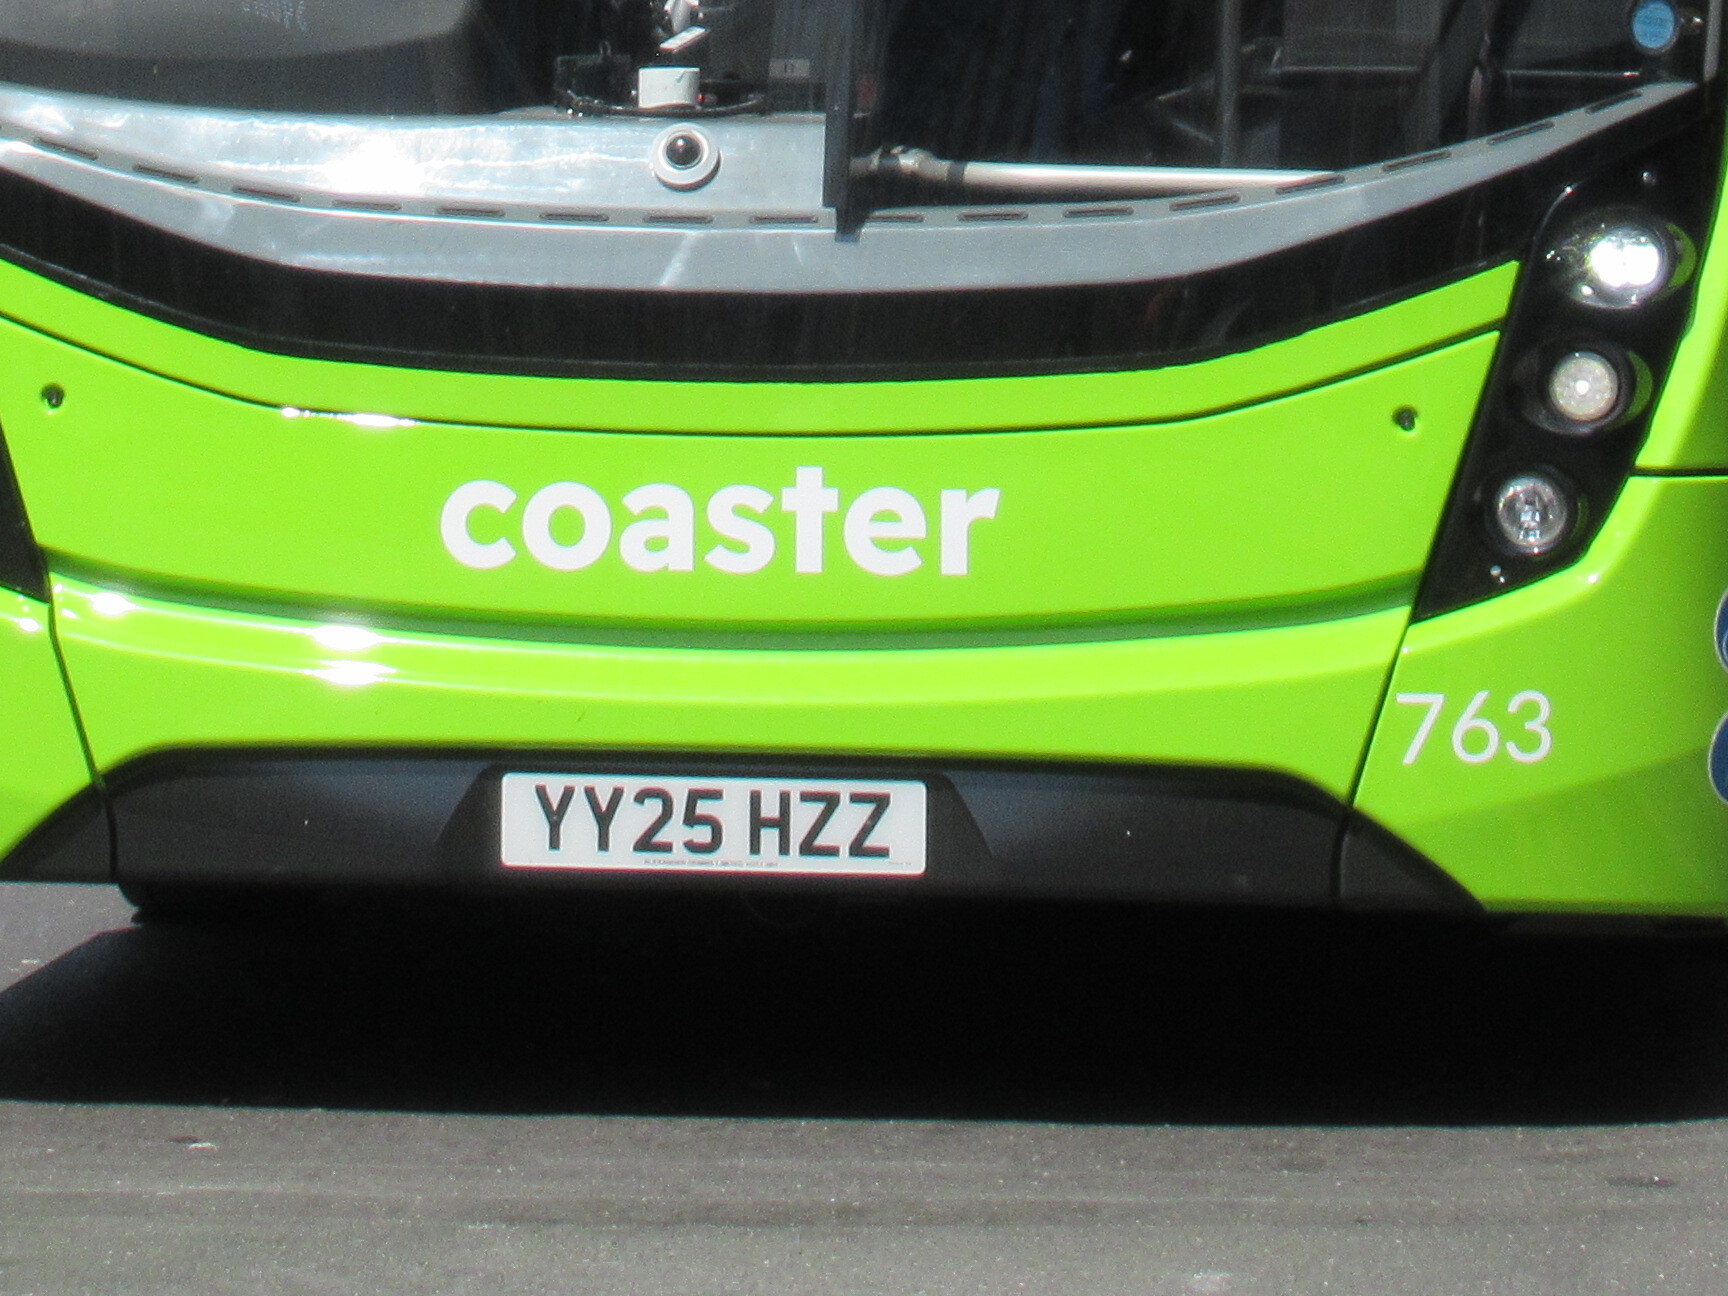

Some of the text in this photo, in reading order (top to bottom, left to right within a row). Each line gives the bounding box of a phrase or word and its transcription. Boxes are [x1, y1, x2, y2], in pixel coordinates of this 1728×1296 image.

[439, 465, 1001, 577] coaster
[1395, 688, 1554, 766] 763
[534, 783, 892, 859] YY25 HZZ
